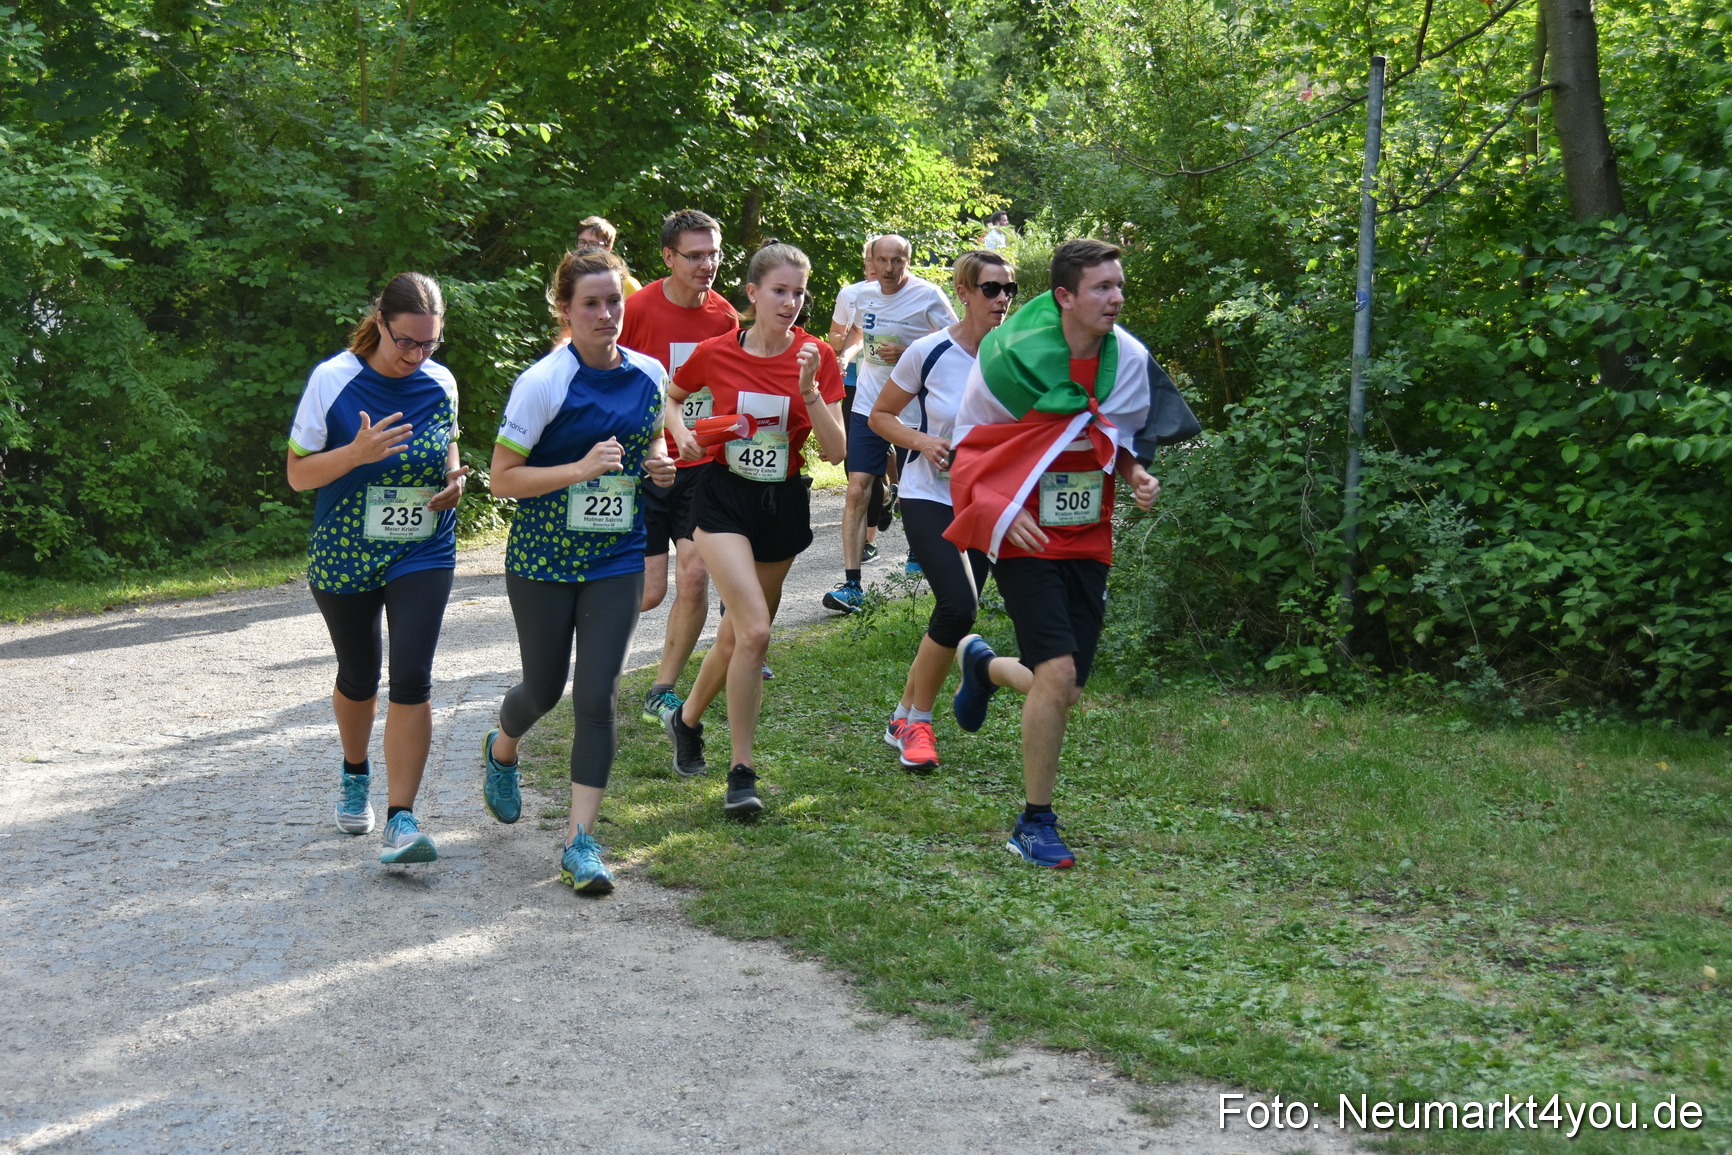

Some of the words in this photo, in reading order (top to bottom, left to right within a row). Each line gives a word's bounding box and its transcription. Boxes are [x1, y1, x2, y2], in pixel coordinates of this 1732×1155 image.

[682, 401, 704, 416] 37
[739, 448, 777, 467] 482
[584, 496, 622, 516] 223
[1055, 491, 1090, 511] 508
[381, 506, 423, 526] 235
